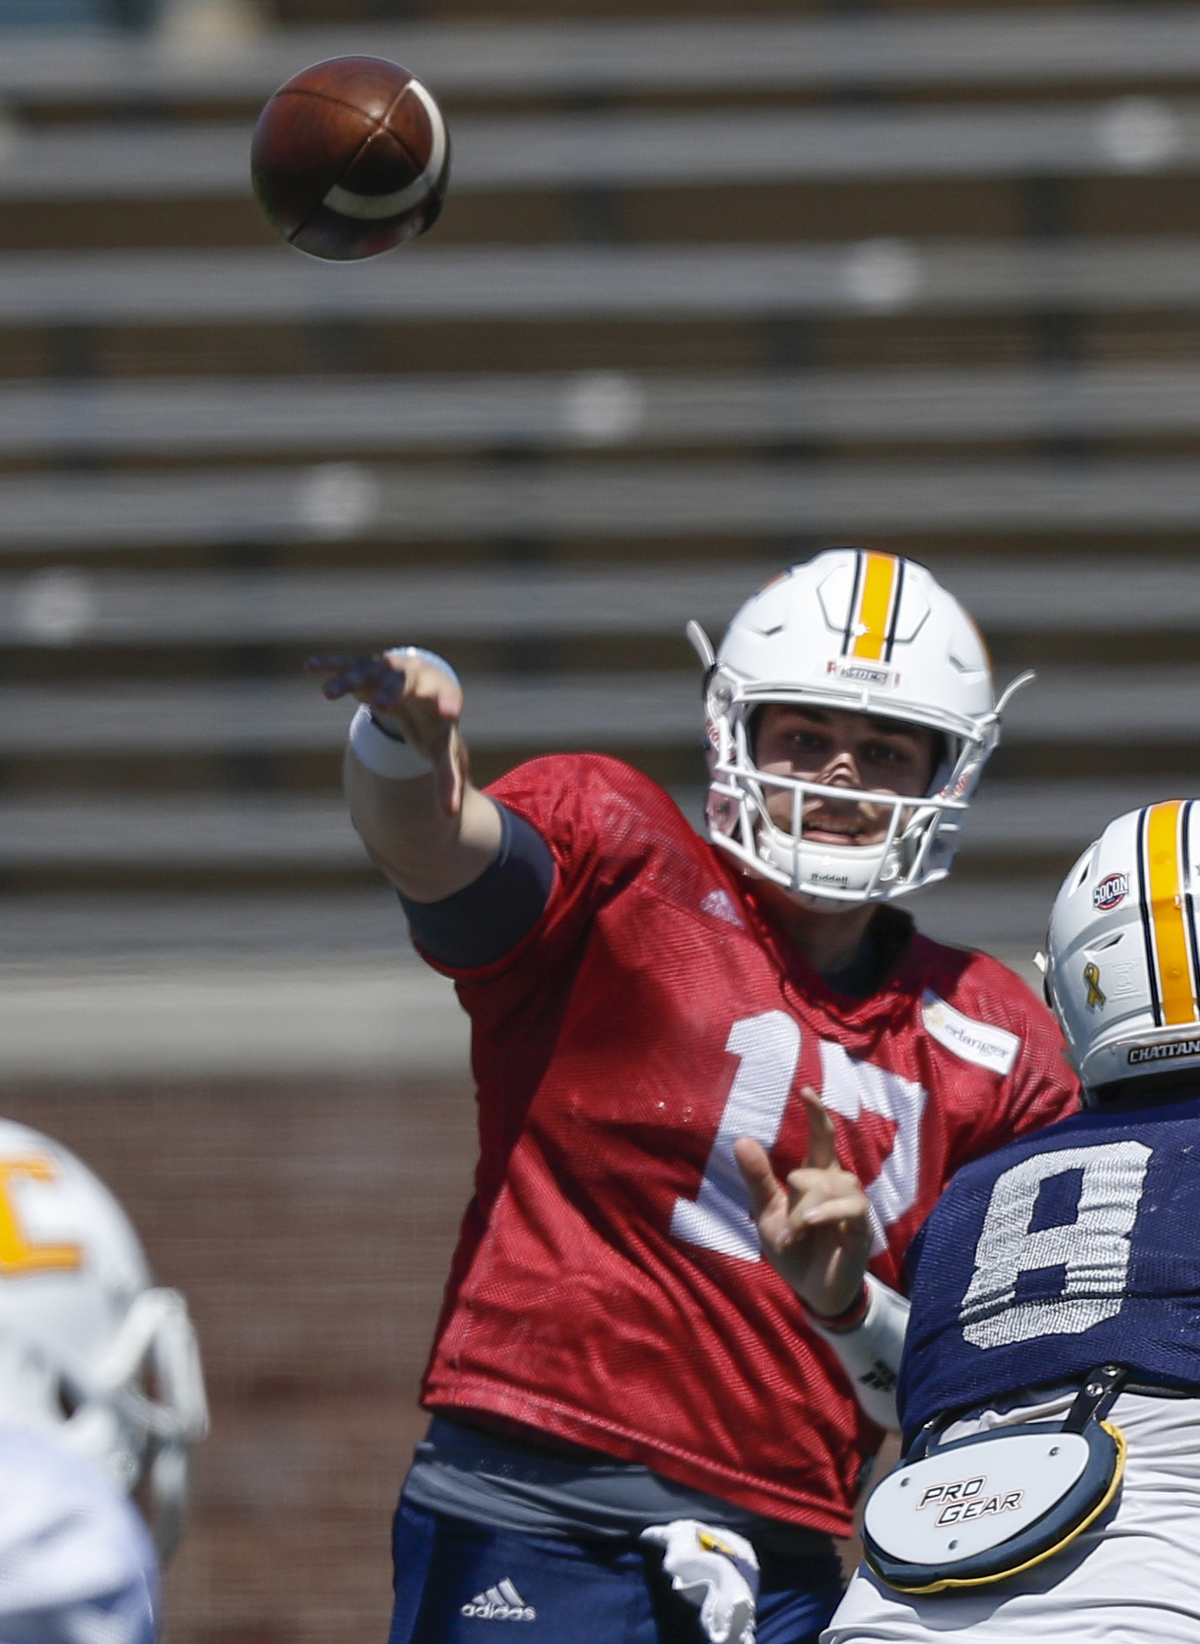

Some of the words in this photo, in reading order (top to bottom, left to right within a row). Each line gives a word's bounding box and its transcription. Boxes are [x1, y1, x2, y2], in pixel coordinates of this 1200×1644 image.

[1093, 873, 1129, 907] SOCON
[945, 1024, 1009, 1058] erlanger
[958, 1140, 1154, 1350] 8
[918, 1477, 985, 1509] PRO
[936, 1491, 1022, 1526] GEAR
[461, 1601, 537, 1621] adidas
